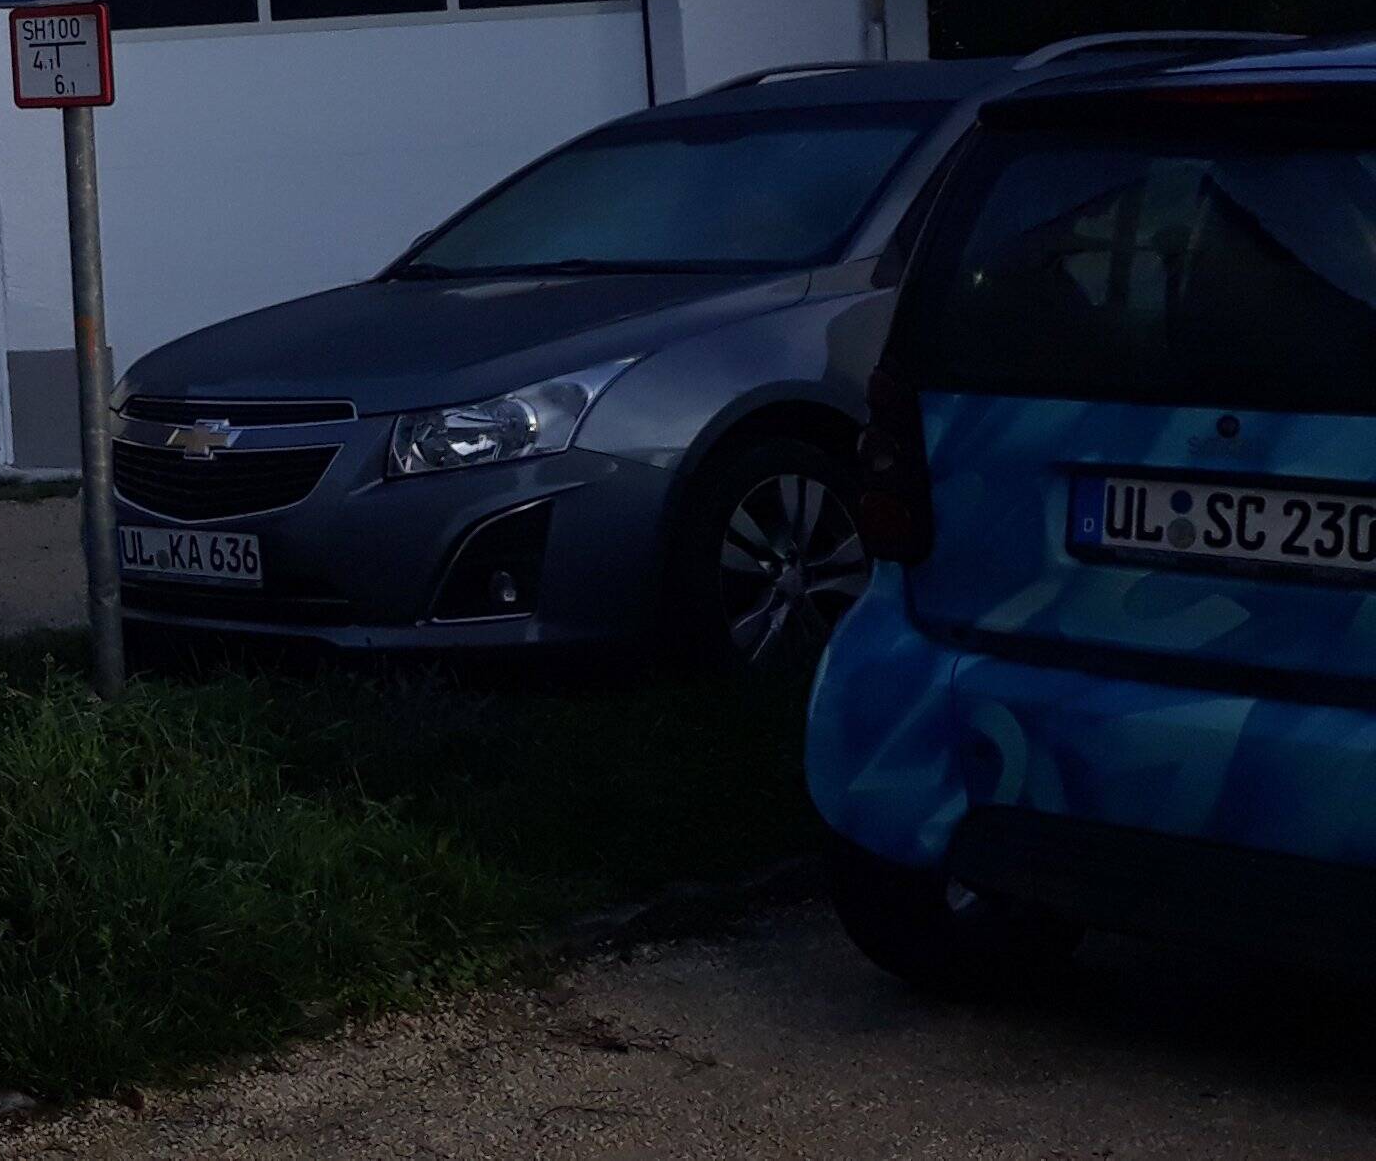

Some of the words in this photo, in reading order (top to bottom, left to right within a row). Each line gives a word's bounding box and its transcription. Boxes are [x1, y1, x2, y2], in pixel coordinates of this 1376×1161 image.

[23, 18, 80, 40] SH100
[1083, 518, 1095, 533] D
[1105, 485, 1163, 542] UL
[1203, 492, 1266, 551] SC
[121, 530, 155, 567] UL
[169, 534, 204, 570] KA
[209, 536, 259, 574] 636
